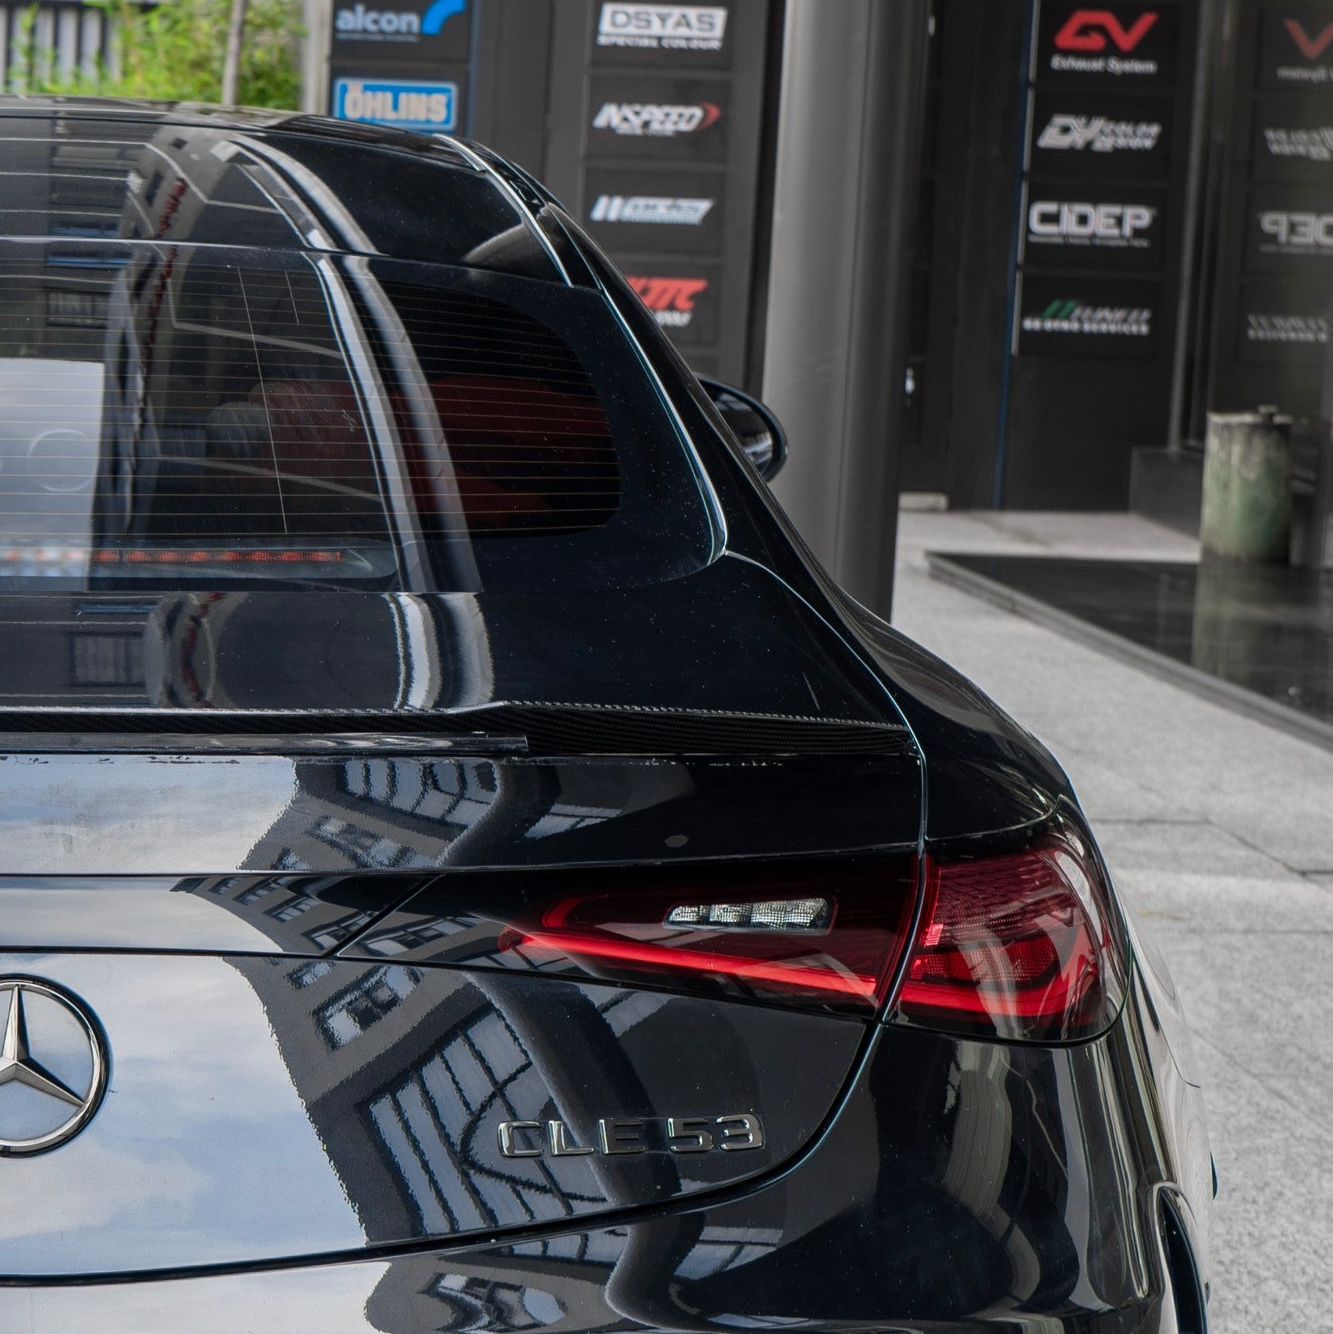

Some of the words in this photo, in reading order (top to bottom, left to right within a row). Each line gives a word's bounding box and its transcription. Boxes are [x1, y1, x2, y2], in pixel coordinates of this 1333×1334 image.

[336, 4, 420, 33] alcon
[610, 10, 716, 33] DSYAS
[1050, 54, 1106, 71] Exhaust
[1106, 57, 1158, 75] System
[343, 81, 449, 123] ÖHLINS
[1028, 201, 1154, 238] CIDEP
